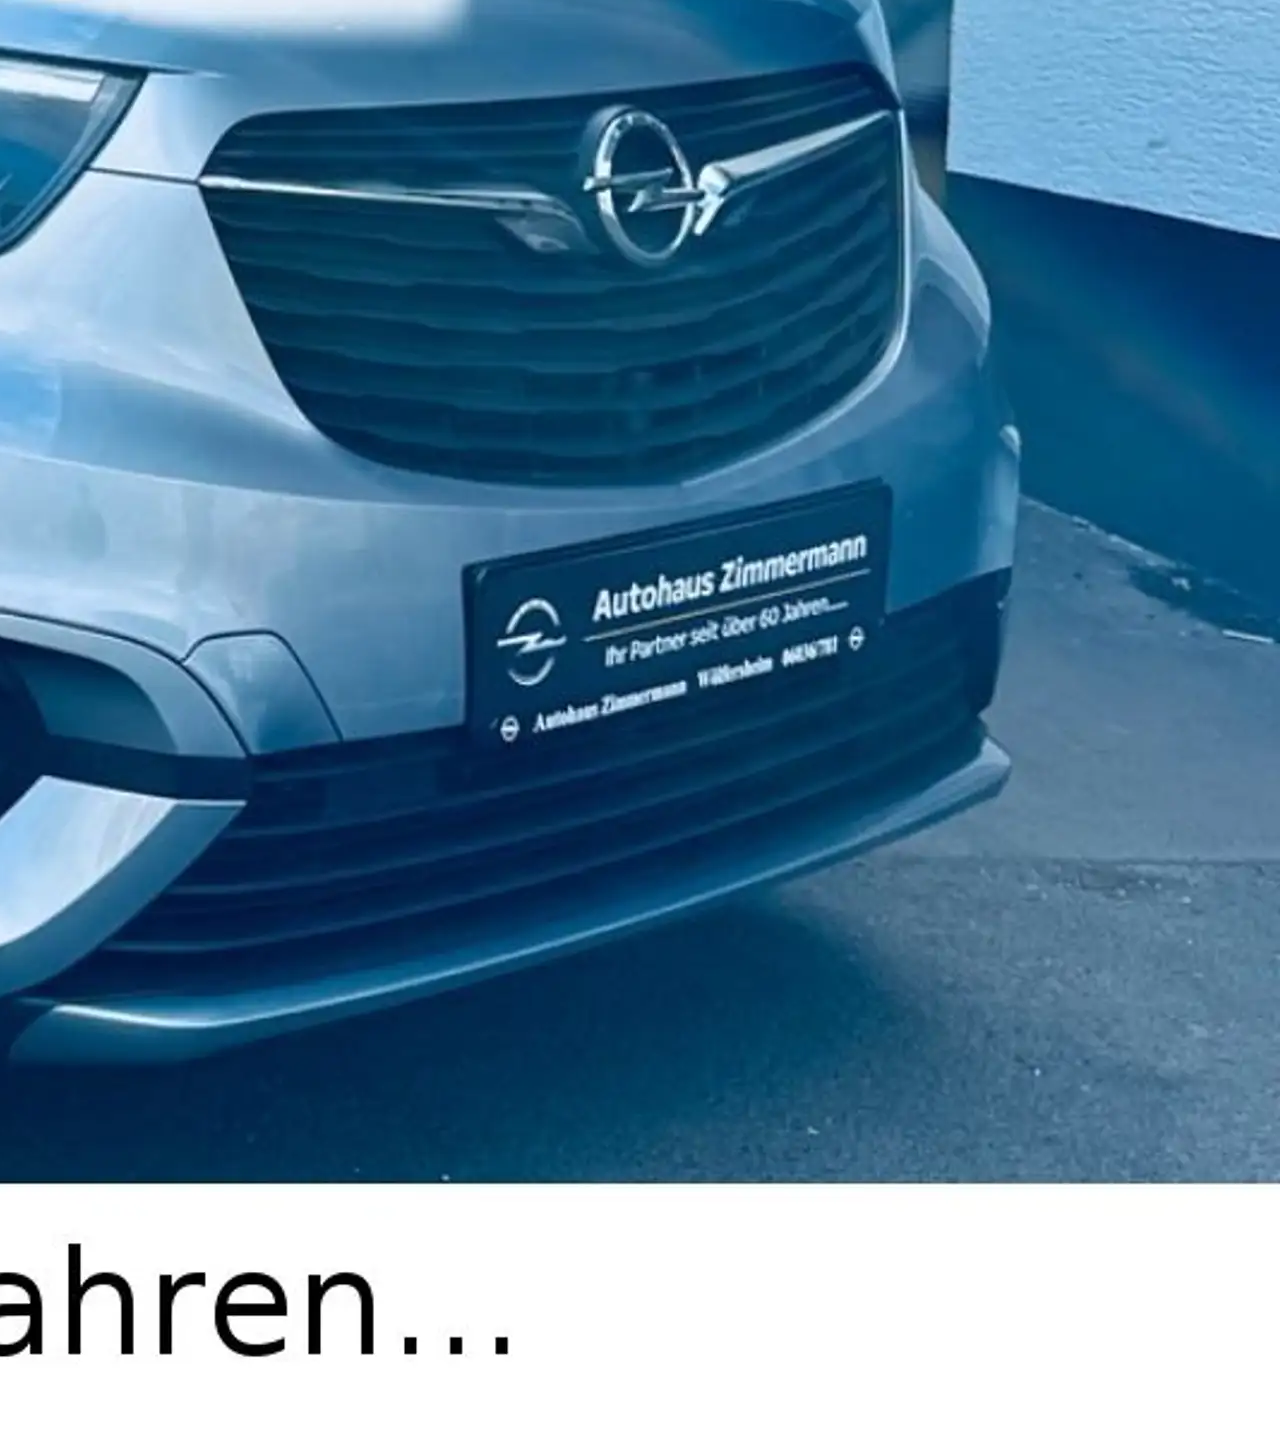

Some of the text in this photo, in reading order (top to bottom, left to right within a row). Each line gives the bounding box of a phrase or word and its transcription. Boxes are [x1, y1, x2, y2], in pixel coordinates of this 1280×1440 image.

[591, 533, 869, 623] Autohaus Zimmermann
[604, 643, 629, 667] Ihr
[630, 631, 688, 661] Partner
[689, 618, 720, 648] seit
[720, 611, 758, 639] über
[758, 607, 781, 630] 60
[531, 702, 600, 734] Autohaus
